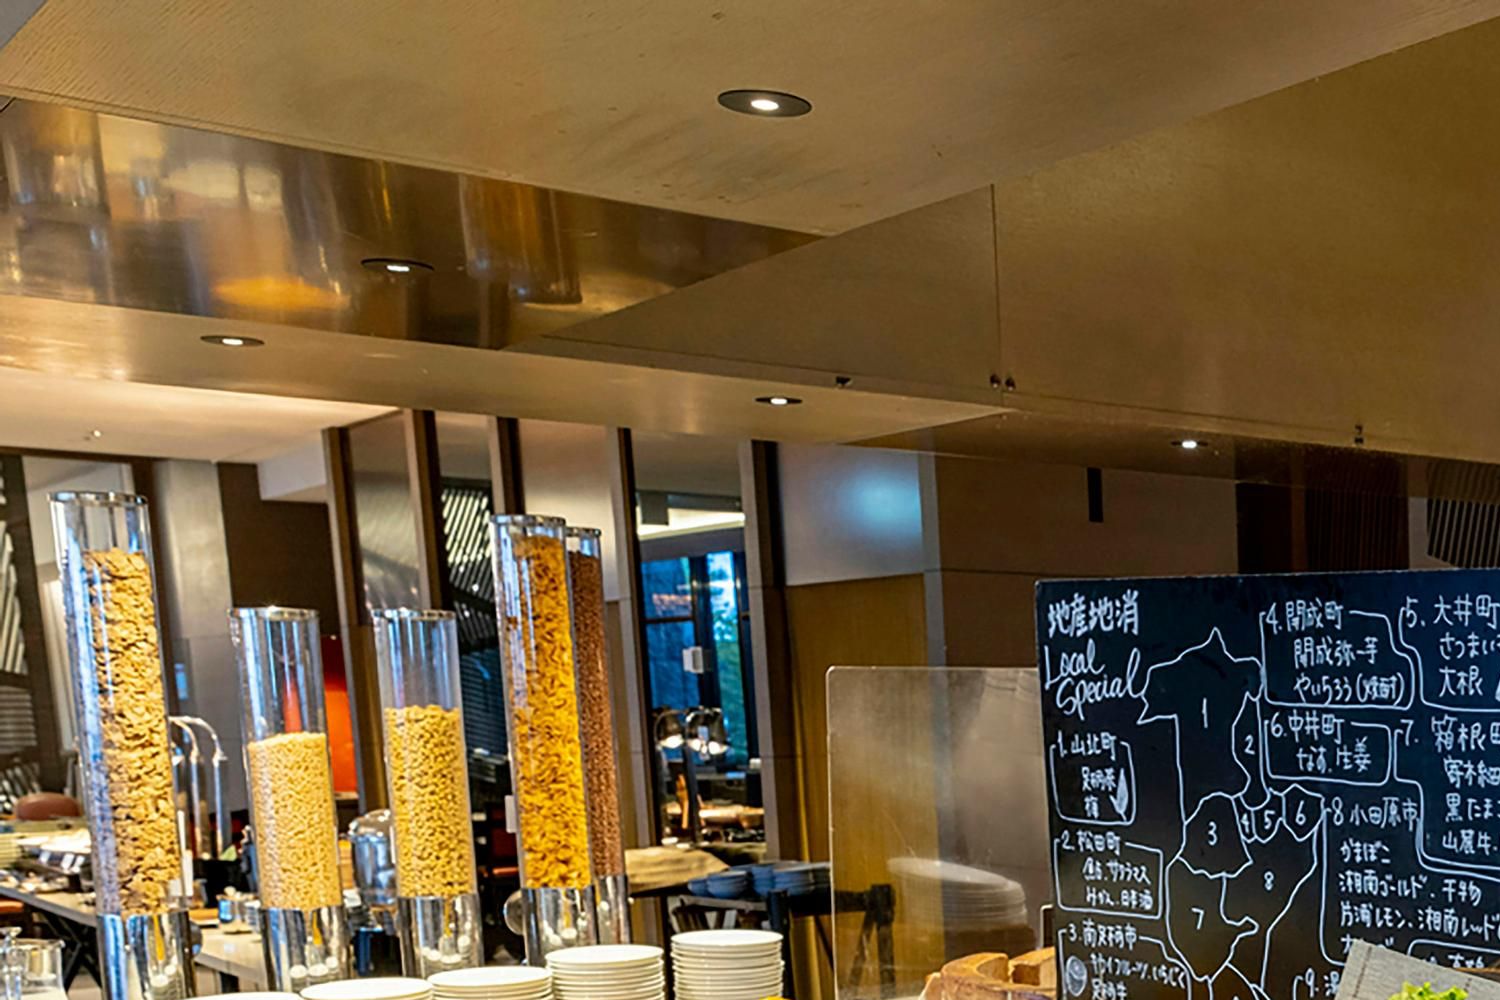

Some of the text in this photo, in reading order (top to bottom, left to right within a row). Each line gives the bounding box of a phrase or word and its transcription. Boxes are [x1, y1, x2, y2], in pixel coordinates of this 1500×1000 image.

[1048, 589, 1139, 638] 地産地消
[1044, 638, 1106, 690] Local
[1055, 647, 1144, 721] Special
[1439, 665, 1484, 697] 大根
[1244, 734, 1256, 755] 2
[1263, 810, 1276, 830] 5
[1295, 800, 1307, 825] 6
[1207, 821, 1218, 846] 3
